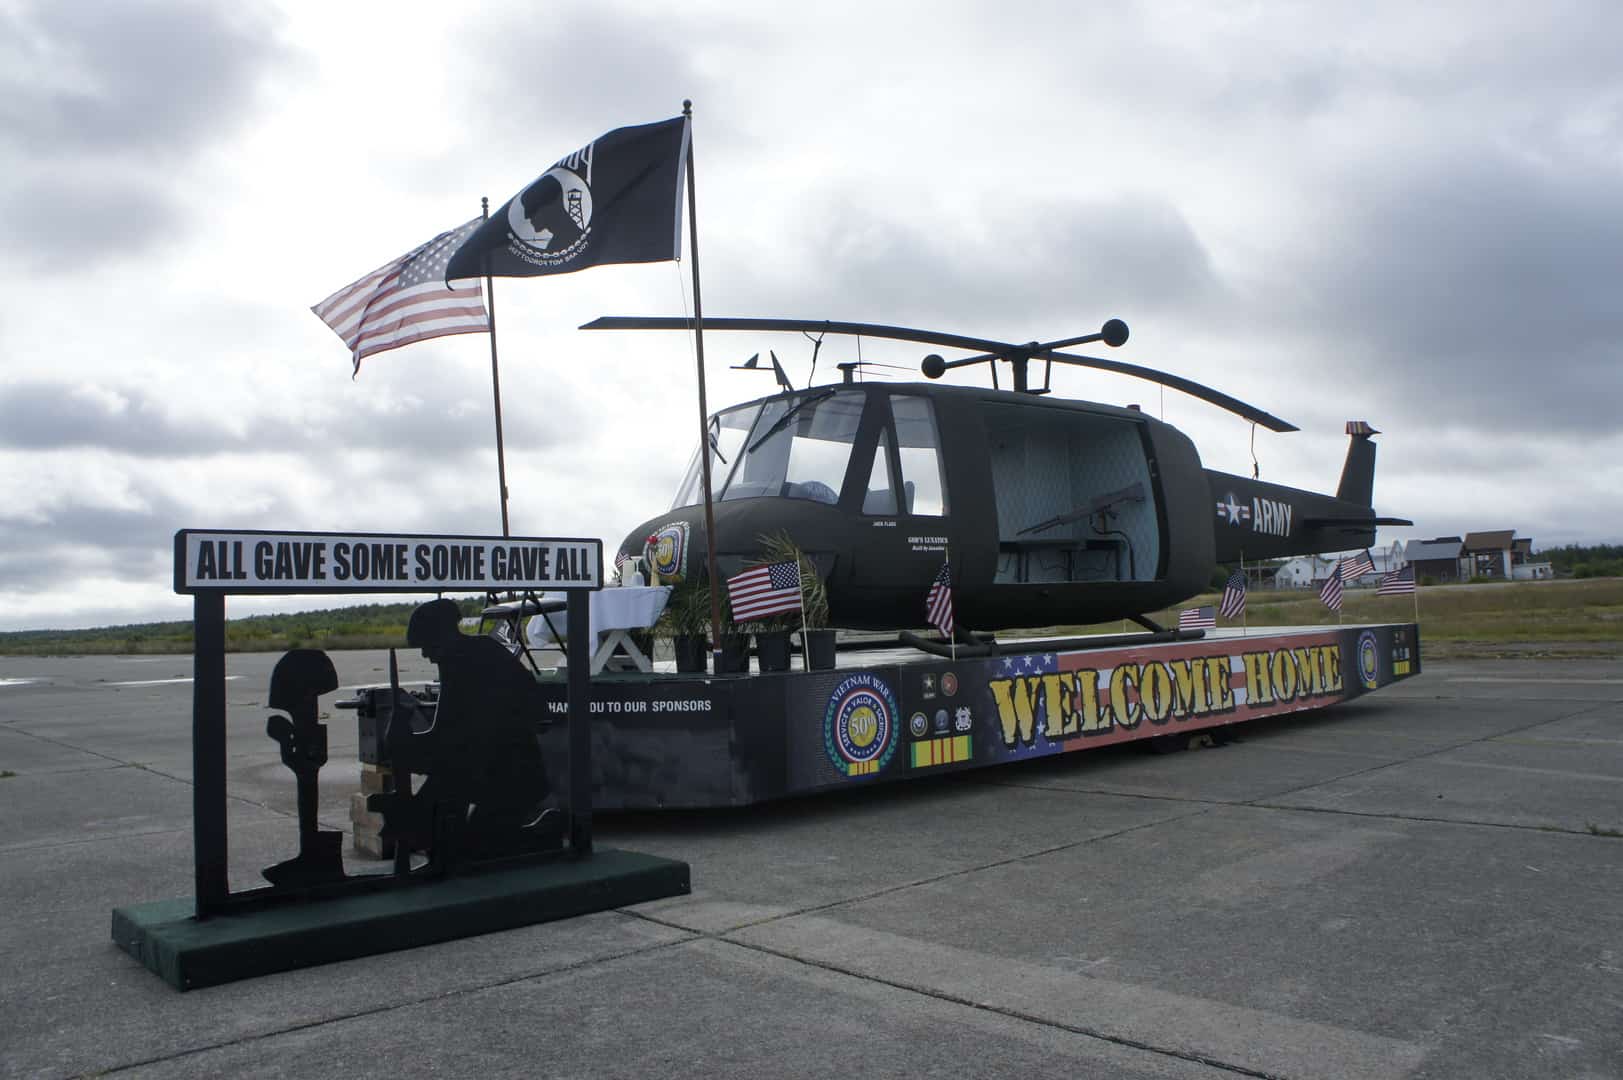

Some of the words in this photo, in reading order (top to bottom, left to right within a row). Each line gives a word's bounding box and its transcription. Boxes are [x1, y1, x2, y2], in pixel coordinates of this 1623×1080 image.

[1252, 497, 1292, 537] ARMY
[196, 540, 247, 580] ALL
[254, 540, 326, 580] GAVE
[333, 542, 409, 581] SOME
[415, 544, 485, 581] SOME
[492, 546, 550, 581] GAVE
[555, 547, 592, 581] ALL
[831, 674, 871, 702] VIETNAM
[872, 676, 890, 699] WAR
[851, 696, 872, 707] VALOR
[988, 654, 1235, 748] WELCOME
[1242, 643, 1344, 708] HOME
[548, 701, 569, 713] HAN
[607, 701, 621, 713] TO
[624, 701, 647, 713] OUR
[652, 700, 712, 713] SPONSORS
[840, 714, 851, 748] SERVICE
